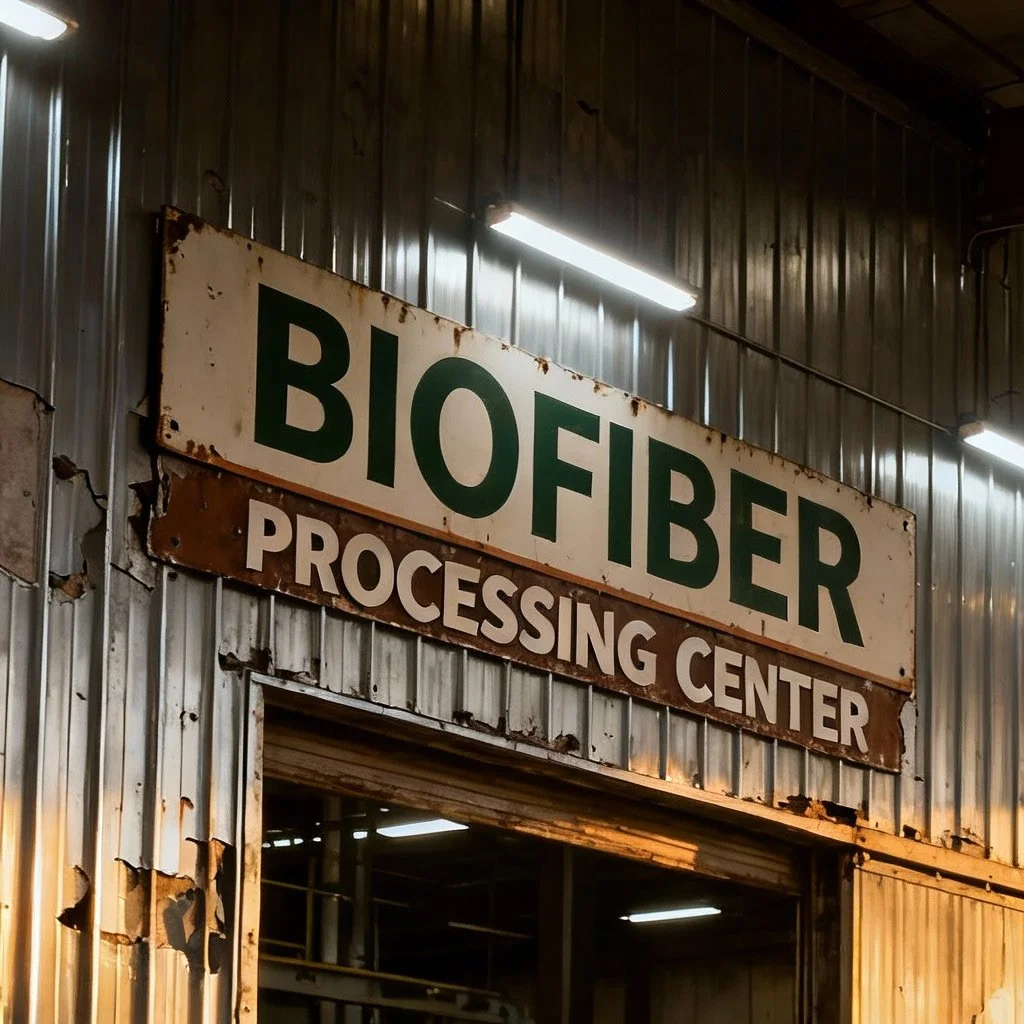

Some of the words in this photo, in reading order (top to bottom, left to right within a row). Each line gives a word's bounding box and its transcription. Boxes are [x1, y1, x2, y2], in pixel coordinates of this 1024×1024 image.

[254, 283, 864, 647] BIOFIBER
[246, 498, 657, 687] PROCESSING
[676, 637, 869, 754] CENTER
